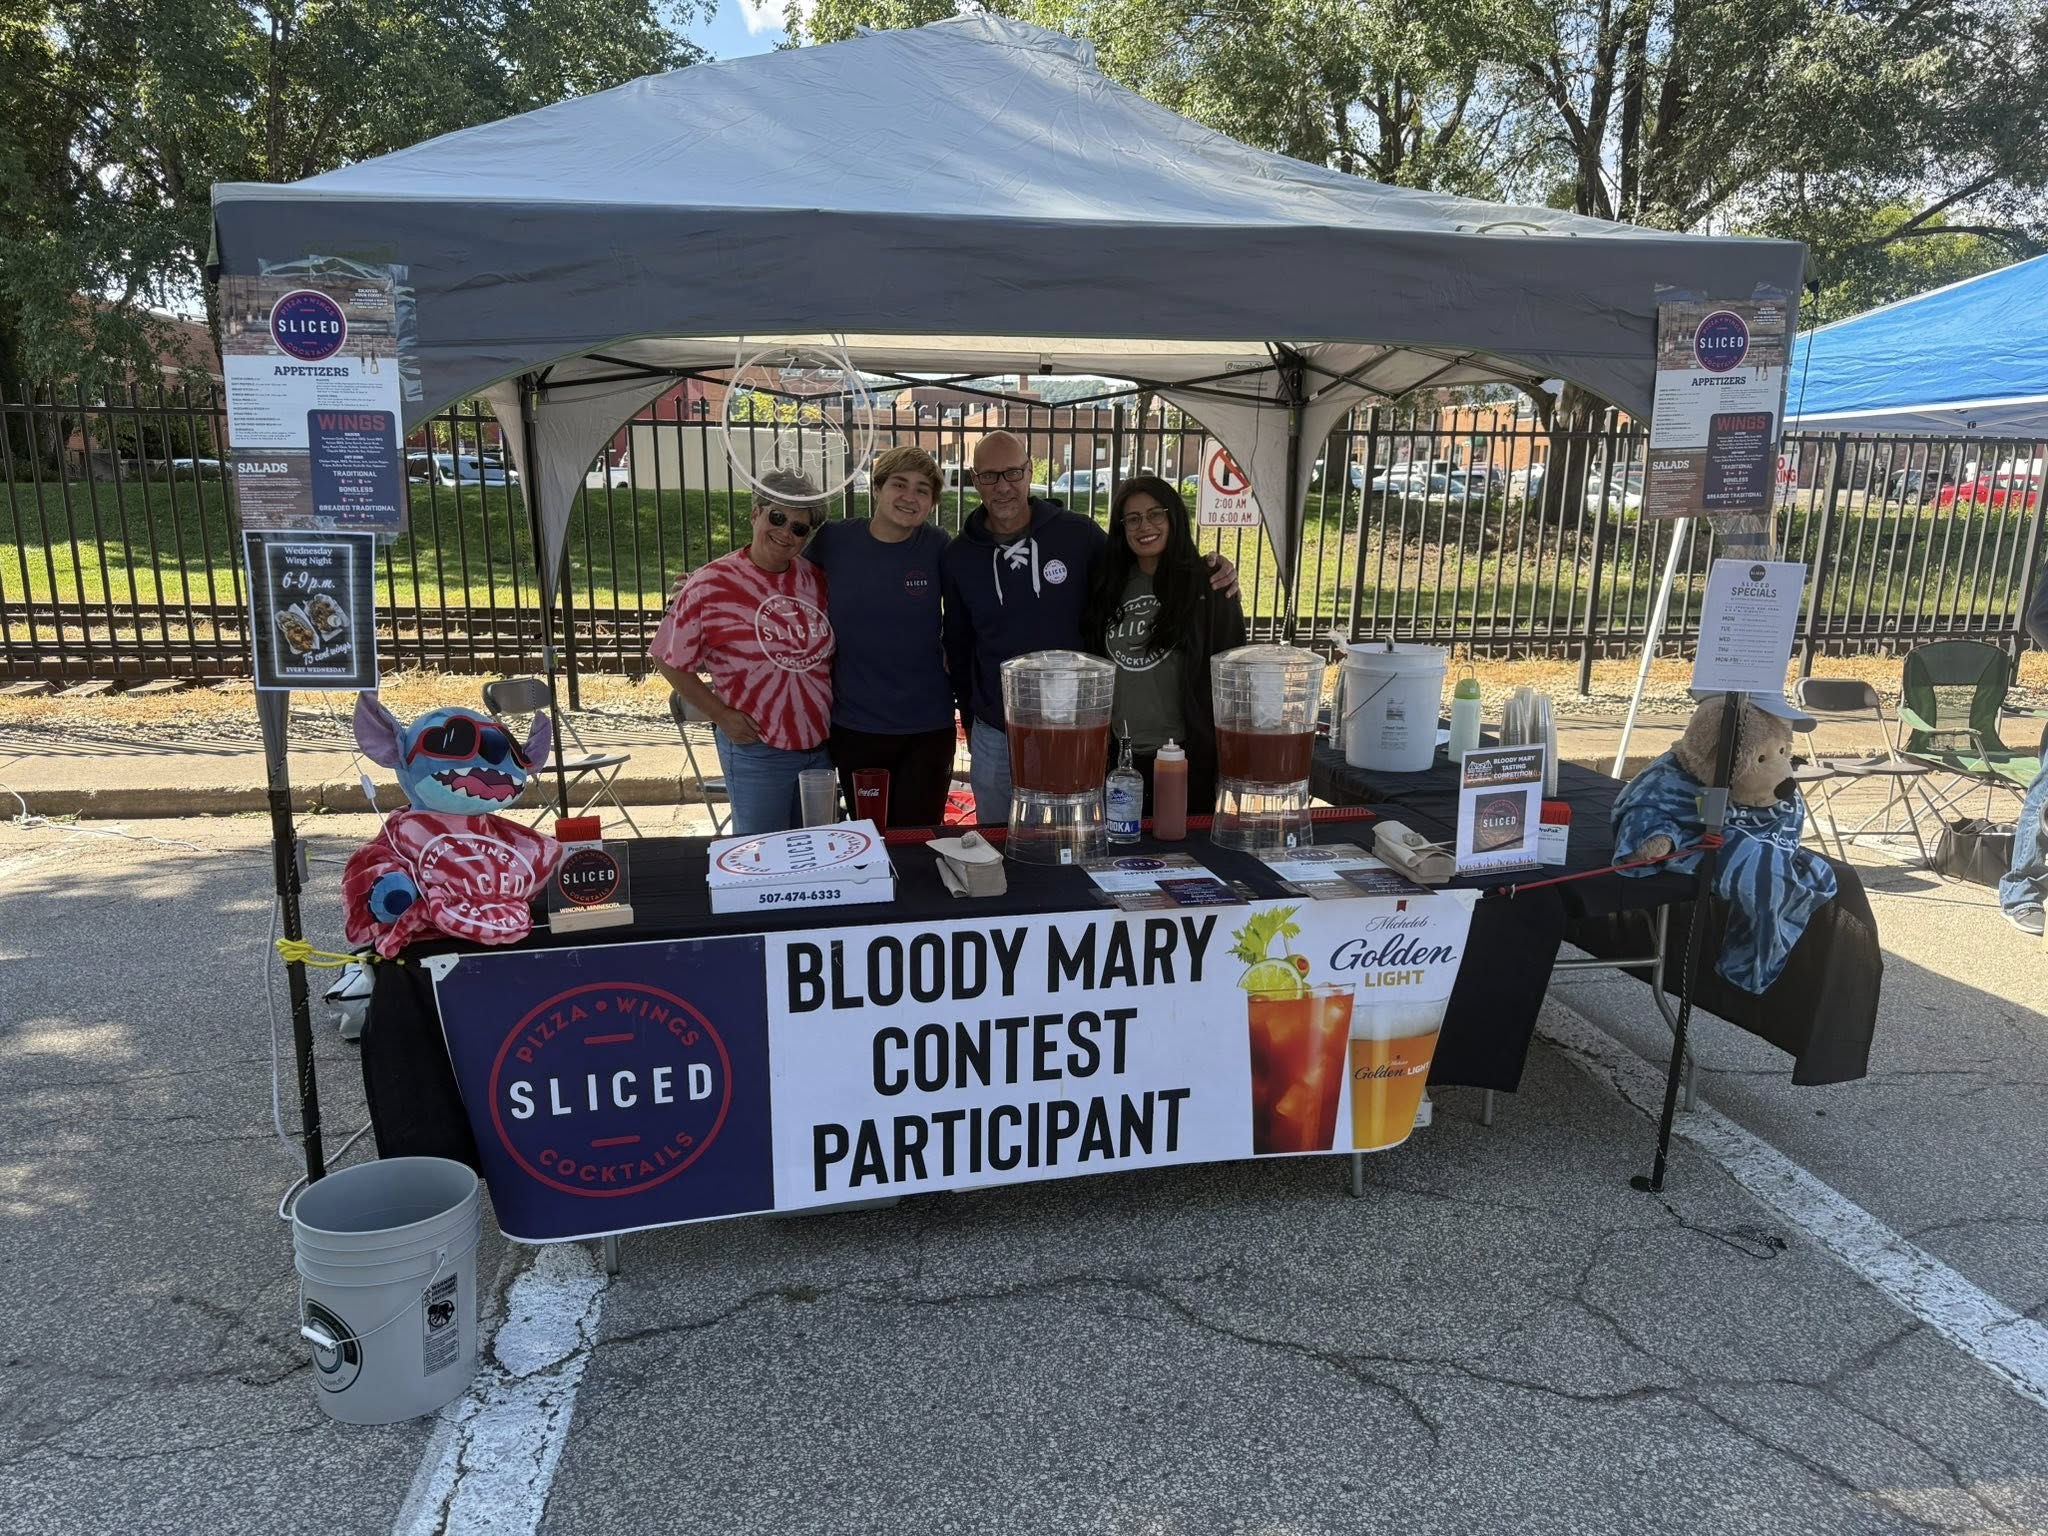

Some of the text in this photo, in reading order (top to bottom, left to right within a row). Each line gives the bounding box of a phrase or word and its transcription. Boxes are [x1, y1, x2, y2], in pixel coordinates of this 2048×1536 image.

[280, 298, 303, 317] PIZZA
[308, 297, 336, 317] WINGS
[278, 319, 340, 334] SLICED
[1699, 336, 1744, 349] SLICED
[274, 366, 349, 377] APPETIZERS
[1692, 376, 1746, 386] APPETIZERS
[317, 414, 386, 431] WINGS
[1717, 416, 1767, 430] WINGS
[238, 462, 289, 474] SALADS
[1652, 460, 1690, 470] SALADS
[333, 470, 378, 478] TRADITIONAL
[319, 504, 351, 512] BREADED
[1214, 498, 1247, 509] 2:00 AM
[1208, 512, 1252, 523] TO 6:00 AM
[284, 547, 333, 555] Wednesday
[285, 556, 333, 566] Wing Night
[282, 571, 336, 594] 6-9 p.m.
[1731, 587, 1777, 598] SPECIALS
[761, 602, 781, 622] PIZZA
[762, 623, 829, 641] SLICED
[302, 653, 314, 666] 75
[1115, 647, 1165, 666] COCKTAILS
[1493, 755, 1536, 765] BLOODY MARY
[1482, 816, 1517, 828] SLICED
[786, 834, 817, 870] SLICED
[422, 841, 518, 880] PIZZA WINGS
[733, 861, 770, 873] PIZZA
[563, 869, 615, 885] SLICED
[758, 889, 841, 903] 507-474-6333
[587, 903, 620, 911] MINNESOTA
[1364, 916, 1430, 932] Michelob
[1329, 933, 1457, 972] Golden
[787, 914, 1218, 1014] BLOODY MARY
[1364, 969, 1425, 988] LIGHT
[515, 995, 700, 1064] PIZZA WINGS
[872, 1007, 1138, 1096] CONTEST
[1354, 1059, 1431, 1080] Golden LIGHT
[509, 1062, 713, 1120] SLICED
[813, 1087, 1191, 1192] PARTICIPANT
[539, 1131, 694, 1183] COCKTAILS
